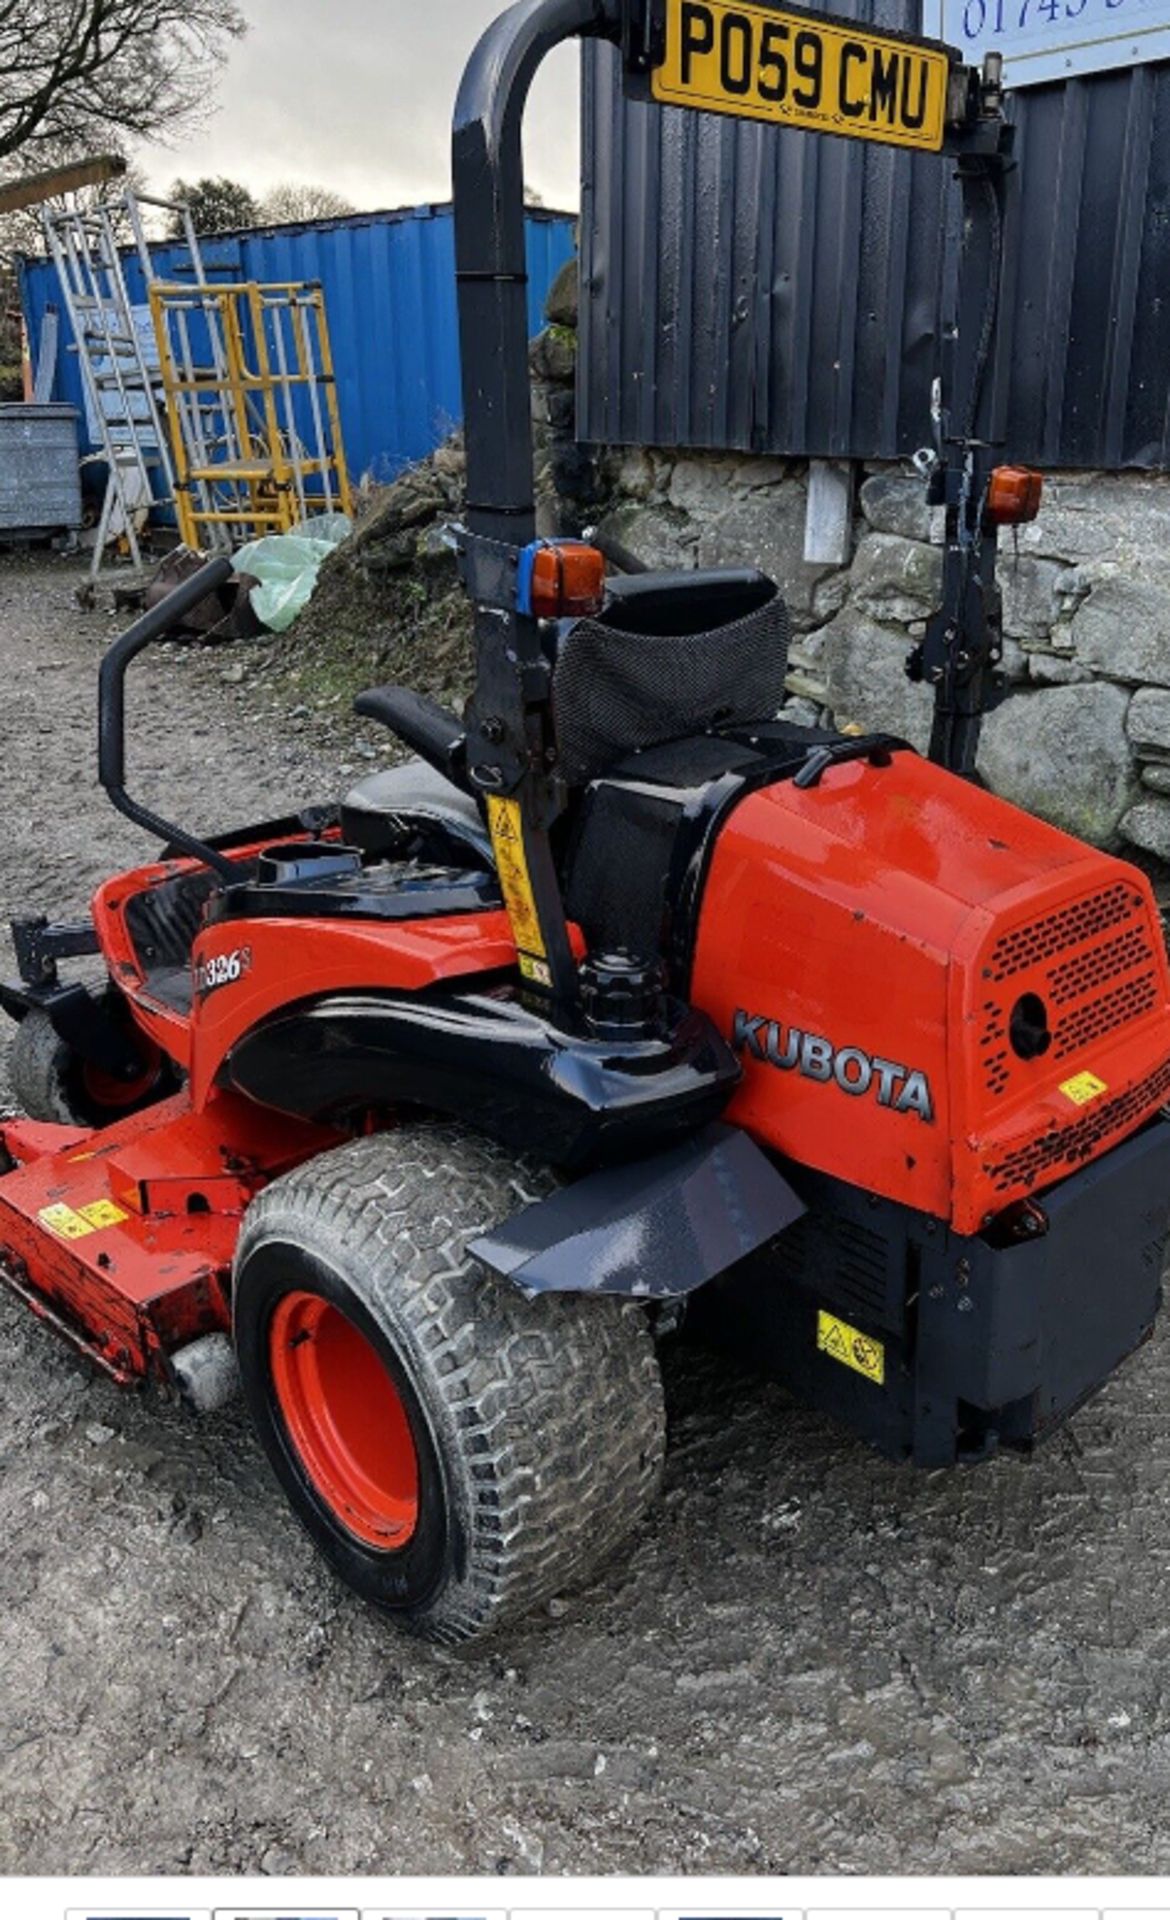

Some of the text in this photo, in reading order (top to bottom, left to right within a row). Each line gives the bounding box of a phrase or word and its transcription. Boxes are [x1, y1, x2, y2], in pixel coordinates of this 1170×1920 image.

[680, 1, 929, 129] PO59 CMU
[733, 1008, 935, 1125] KUBOTA
